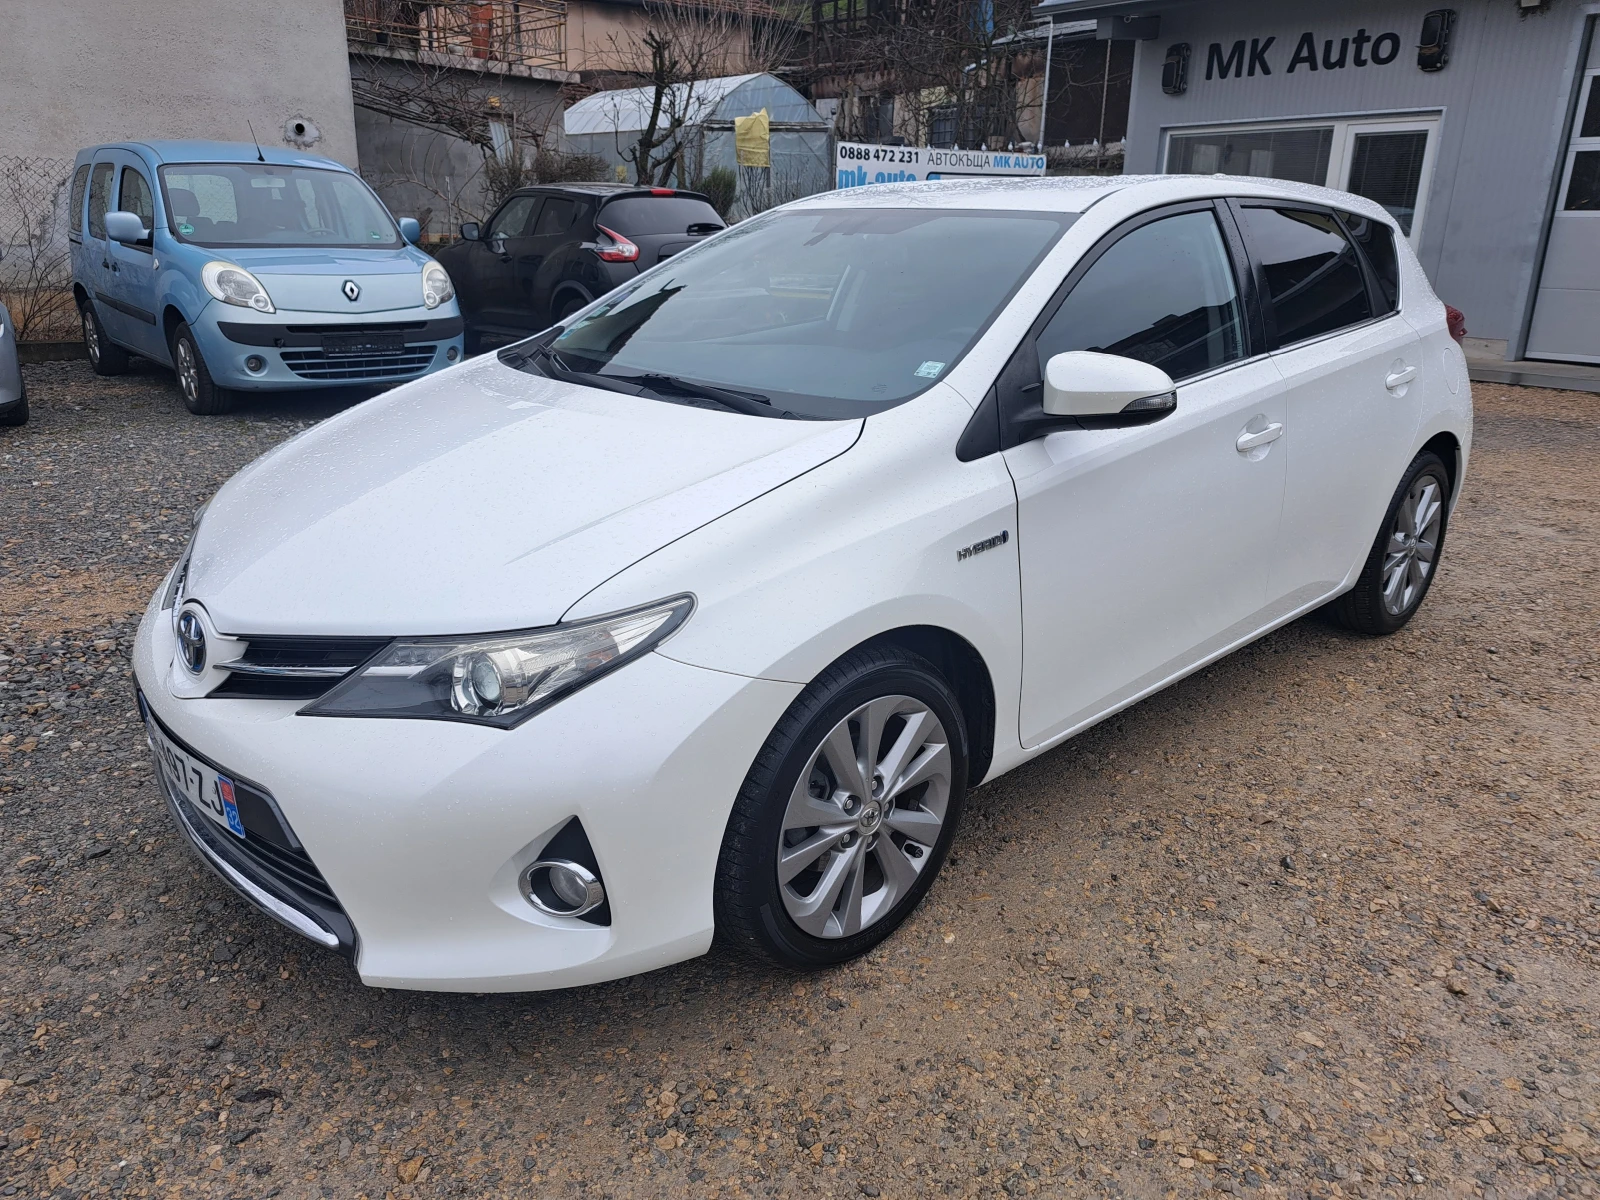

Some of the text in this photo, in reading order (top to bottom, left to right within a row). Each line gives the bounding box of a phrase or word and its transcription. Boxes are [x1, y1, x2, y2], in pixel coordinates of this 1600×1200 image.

[1205, 28, 1400, 81] MK Auto
[840, 146, 919, 164] 0888 472 231
[927, 152, 990, 168] АВТОКЪЩА
[993, 155, 1044, 170] MK AUTO
[226, 806, 241, 830] 32
